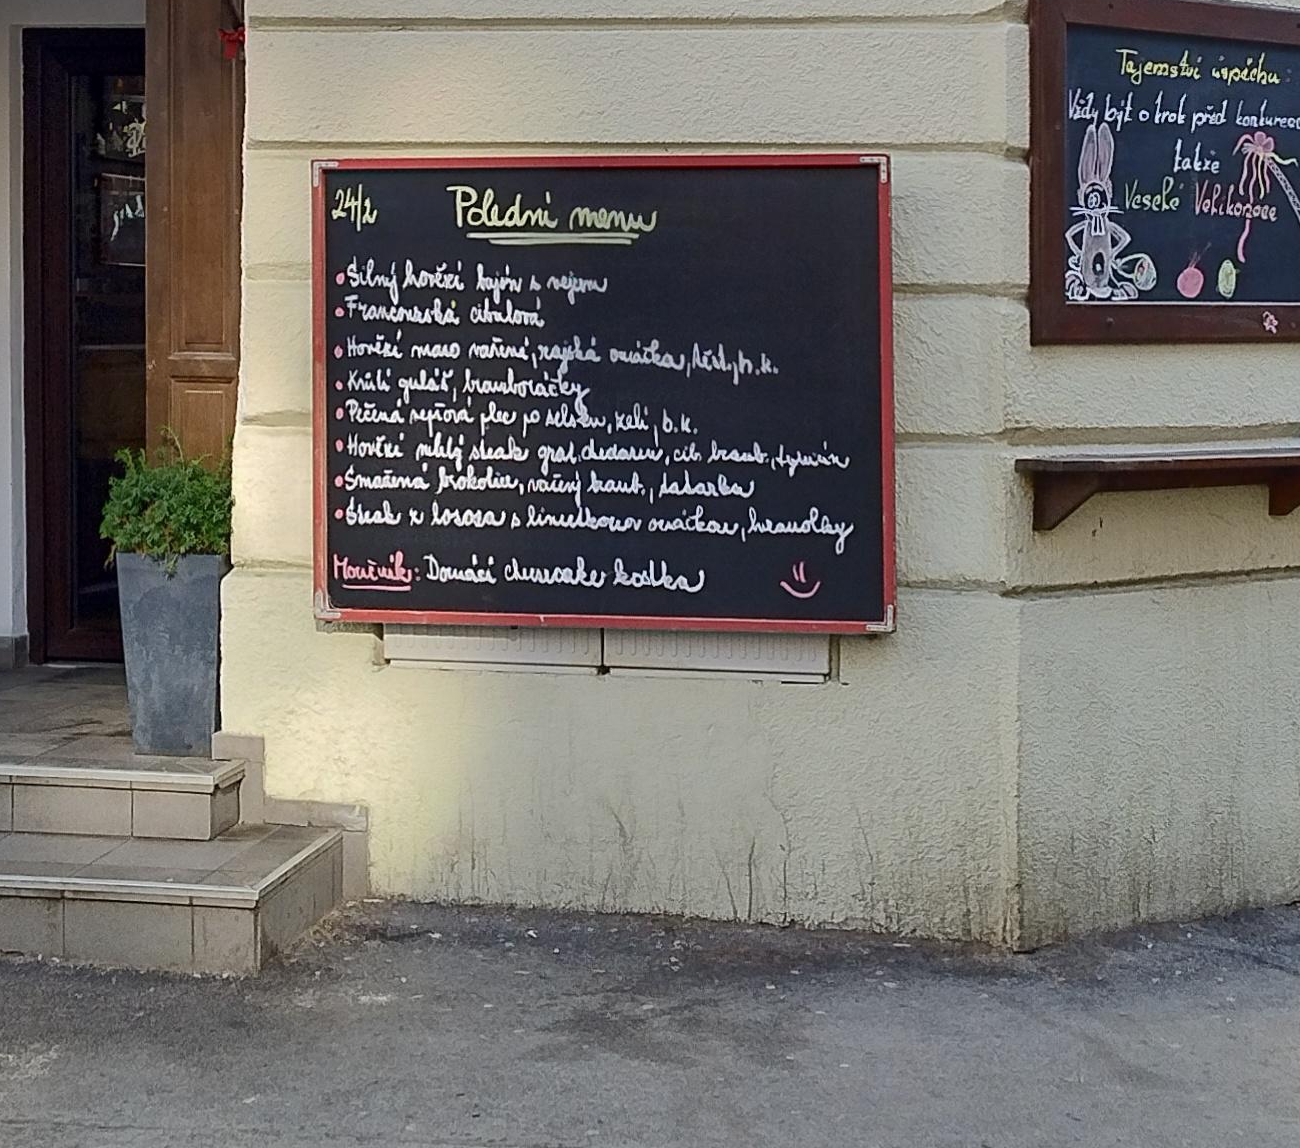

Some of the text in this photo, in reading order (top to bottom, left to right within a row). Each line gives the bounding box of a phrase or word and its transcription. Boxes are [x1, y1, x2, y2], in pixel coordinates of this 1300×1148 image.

[1138, 109, 1151, 125] o
[1153, 89, 1188, 127] krok
[331, 182, 658, 234] 24/2 Polední menu
[346, 255, 399, 305] Silný
[528, 274, 542, 290] s
[469, 295, 546, 329] cibulová
[410, 339, 461, 360] maso
[344, 397, 406, 424] Pečená
[522, 407, 541, 440] po
[468, 435, 529, 463] steak
[344, 495, 402, 527] Steak
[408, 507, 425, 527] z
[510, 511, 522, 531] s
